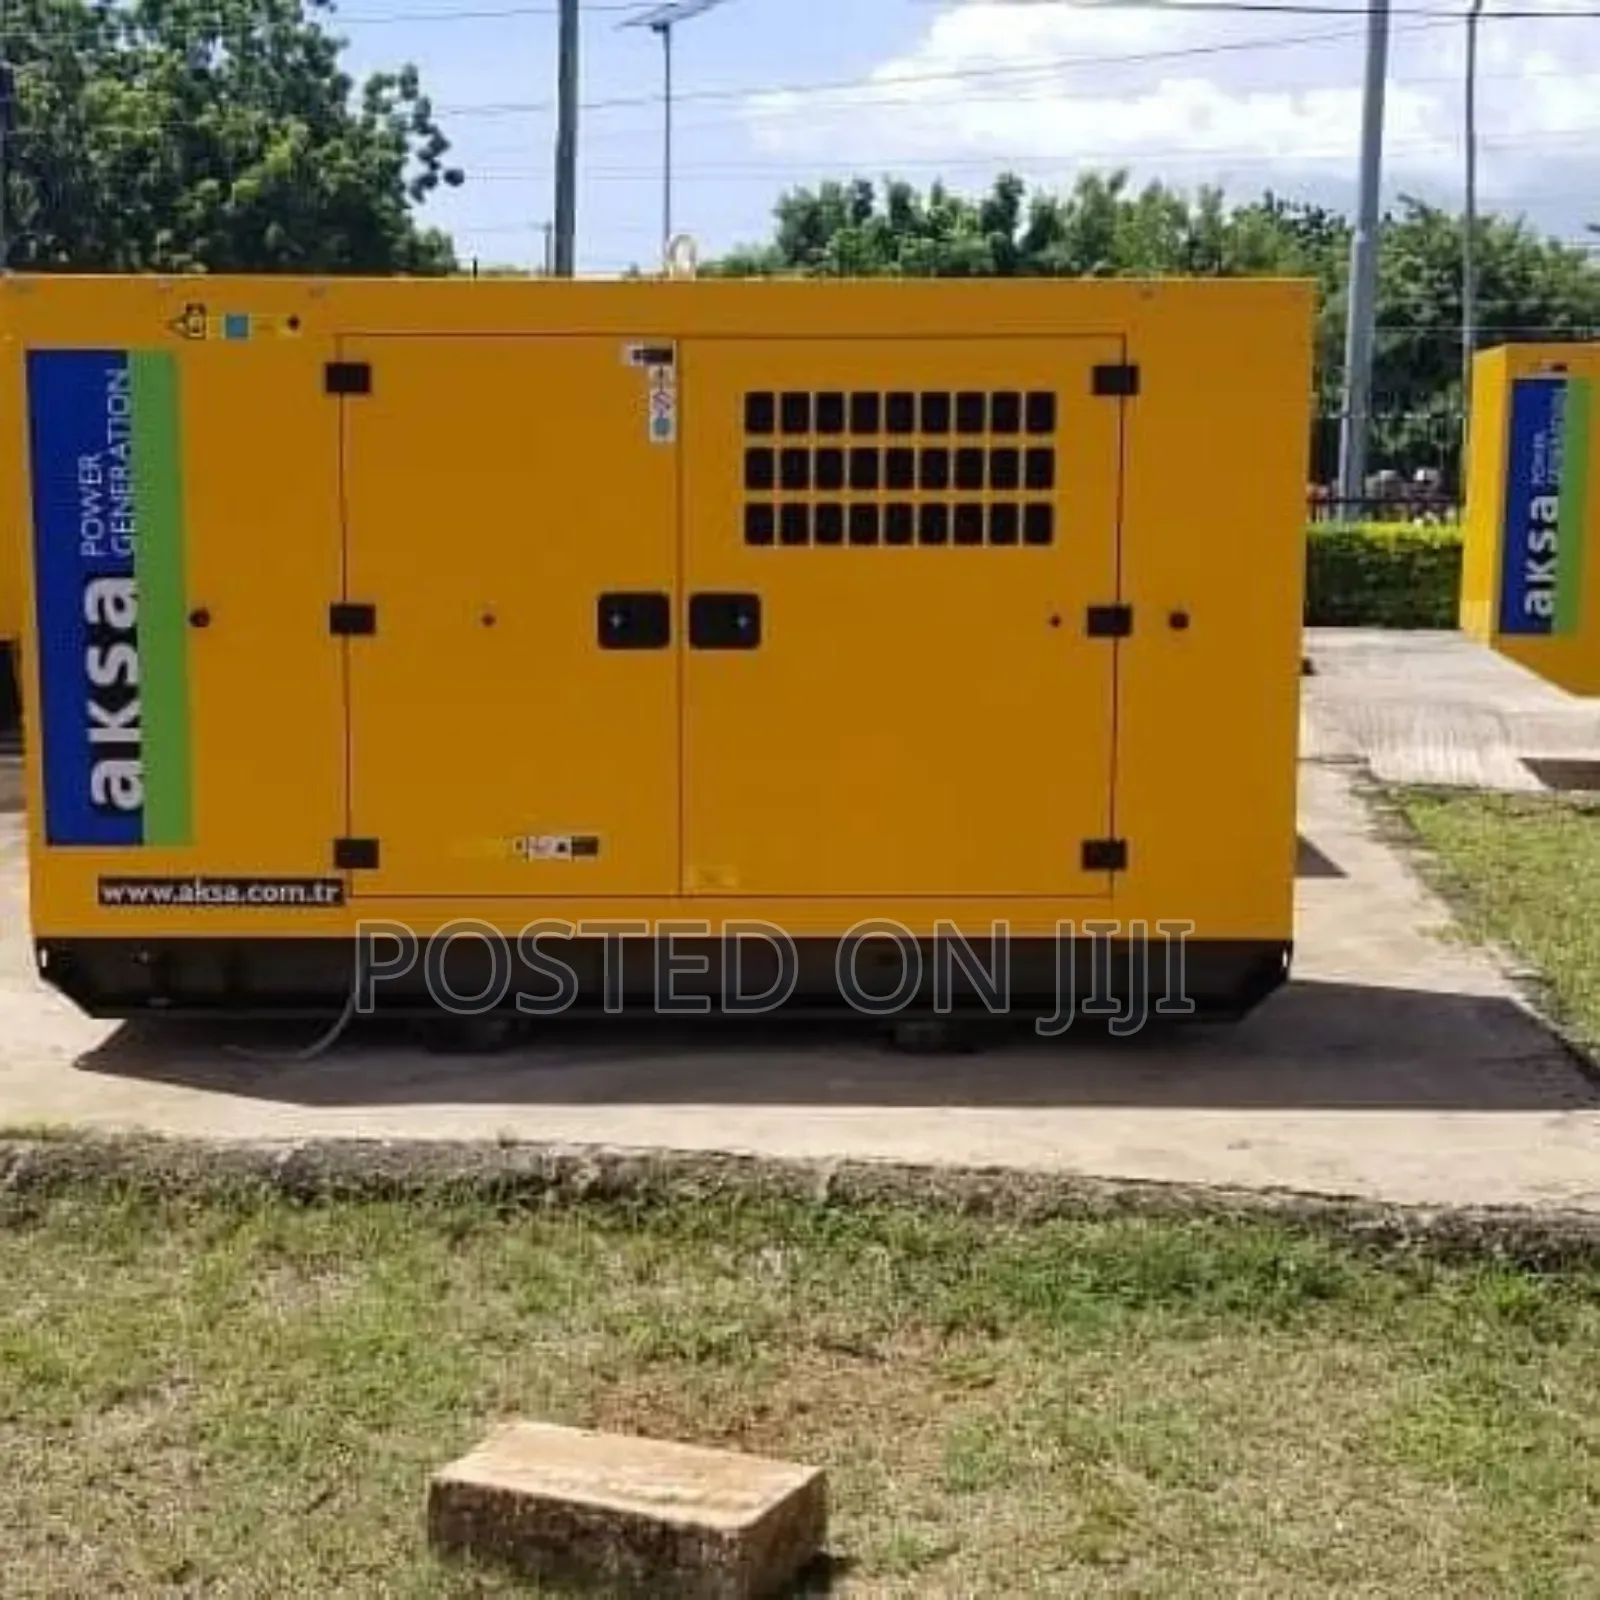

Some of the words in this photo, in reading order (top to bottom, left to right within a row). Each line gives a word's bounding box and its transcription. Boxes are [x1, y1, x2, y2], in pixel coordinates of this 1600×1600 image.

[78, 452, 104, 557] POWER
[106, 368, 137, 557] GENERATION
[1523, 495, 1559, 619] aksa
[84, 578, 144, 810] aksa
[102, 878, 340, 902] www.aksa.com.tr
